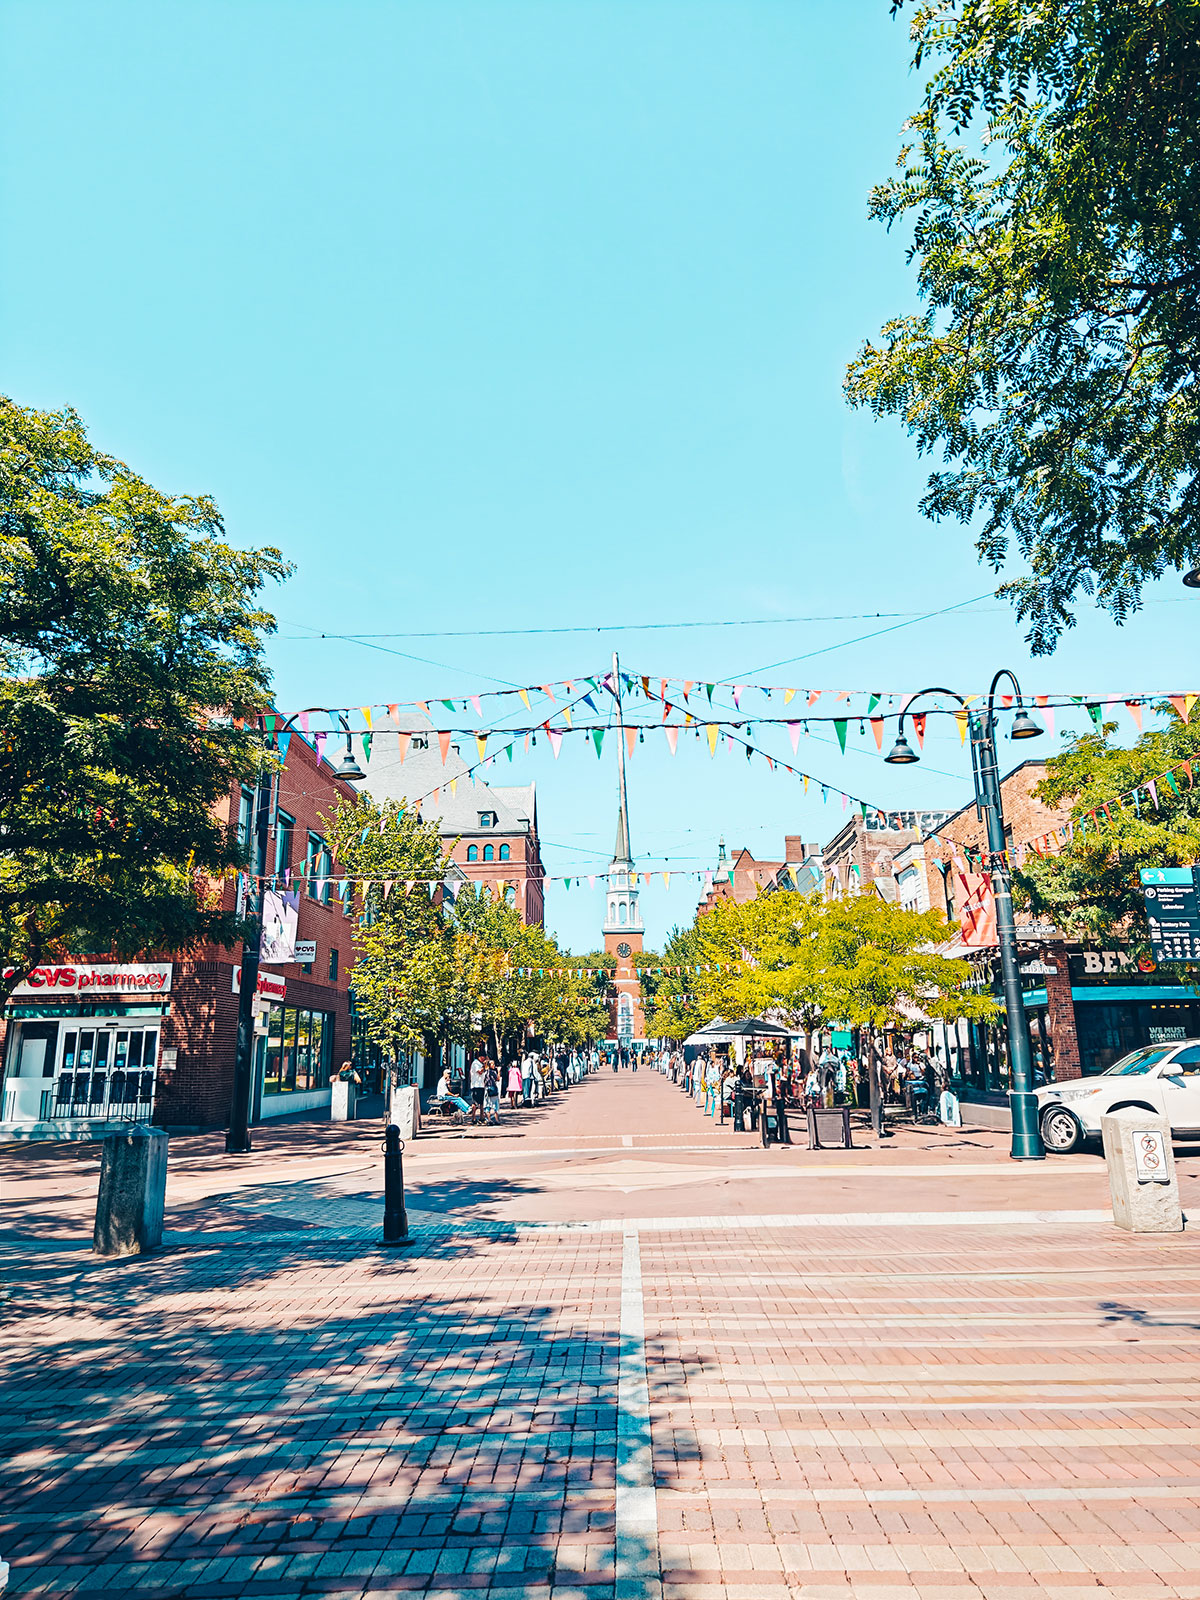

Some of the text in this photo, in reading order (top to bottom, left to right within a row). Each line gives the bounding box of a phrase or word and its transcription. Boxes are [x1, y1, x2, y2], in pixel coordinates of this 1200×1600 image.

[1083, 951, 1138, 973] BEN
[26, 968, 167, 990] CVS pharmacy
